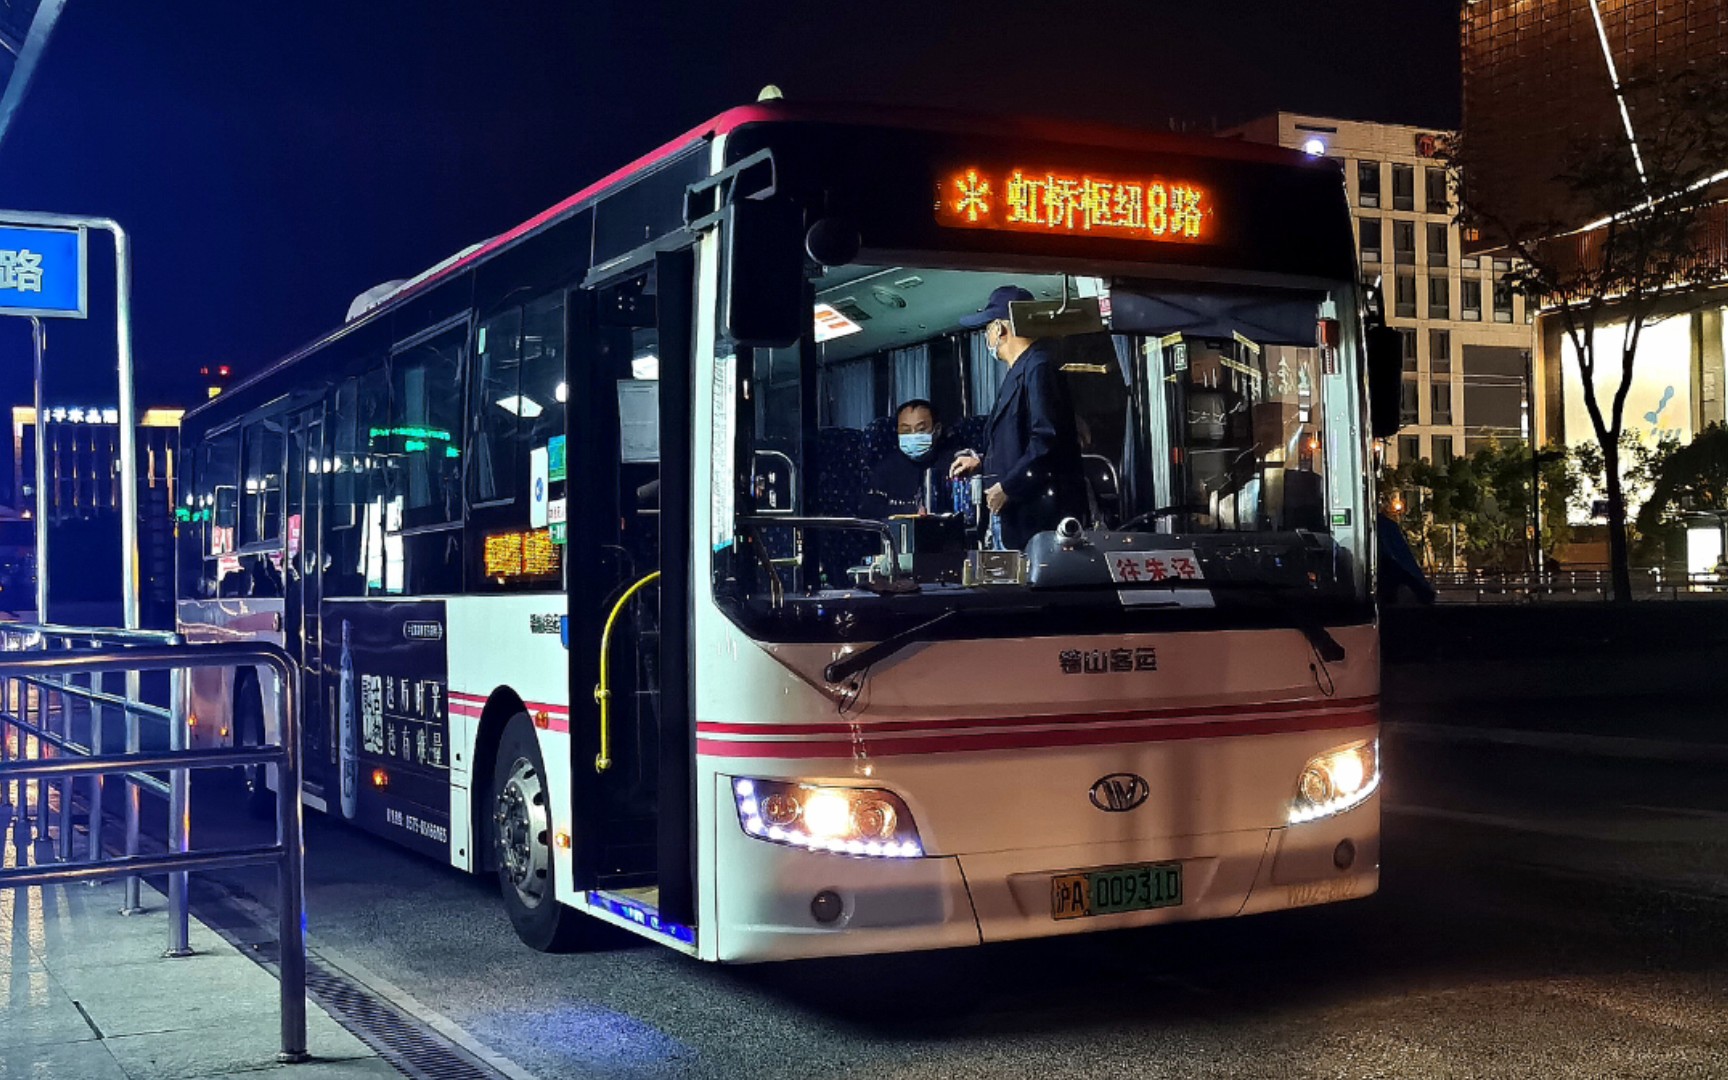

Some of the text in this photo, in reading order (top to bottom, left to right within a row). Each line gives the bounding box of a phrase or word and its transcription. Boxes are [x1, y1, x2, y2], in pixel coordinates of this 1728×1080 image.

[1005, 171, 1202, 238] 虹桥枢纽8路
[0, 249, 44, 293] 路
[1116, 557, 1196, 582] 往朱泾
[1056, 871, 1179, 913] 沪A 00931D
